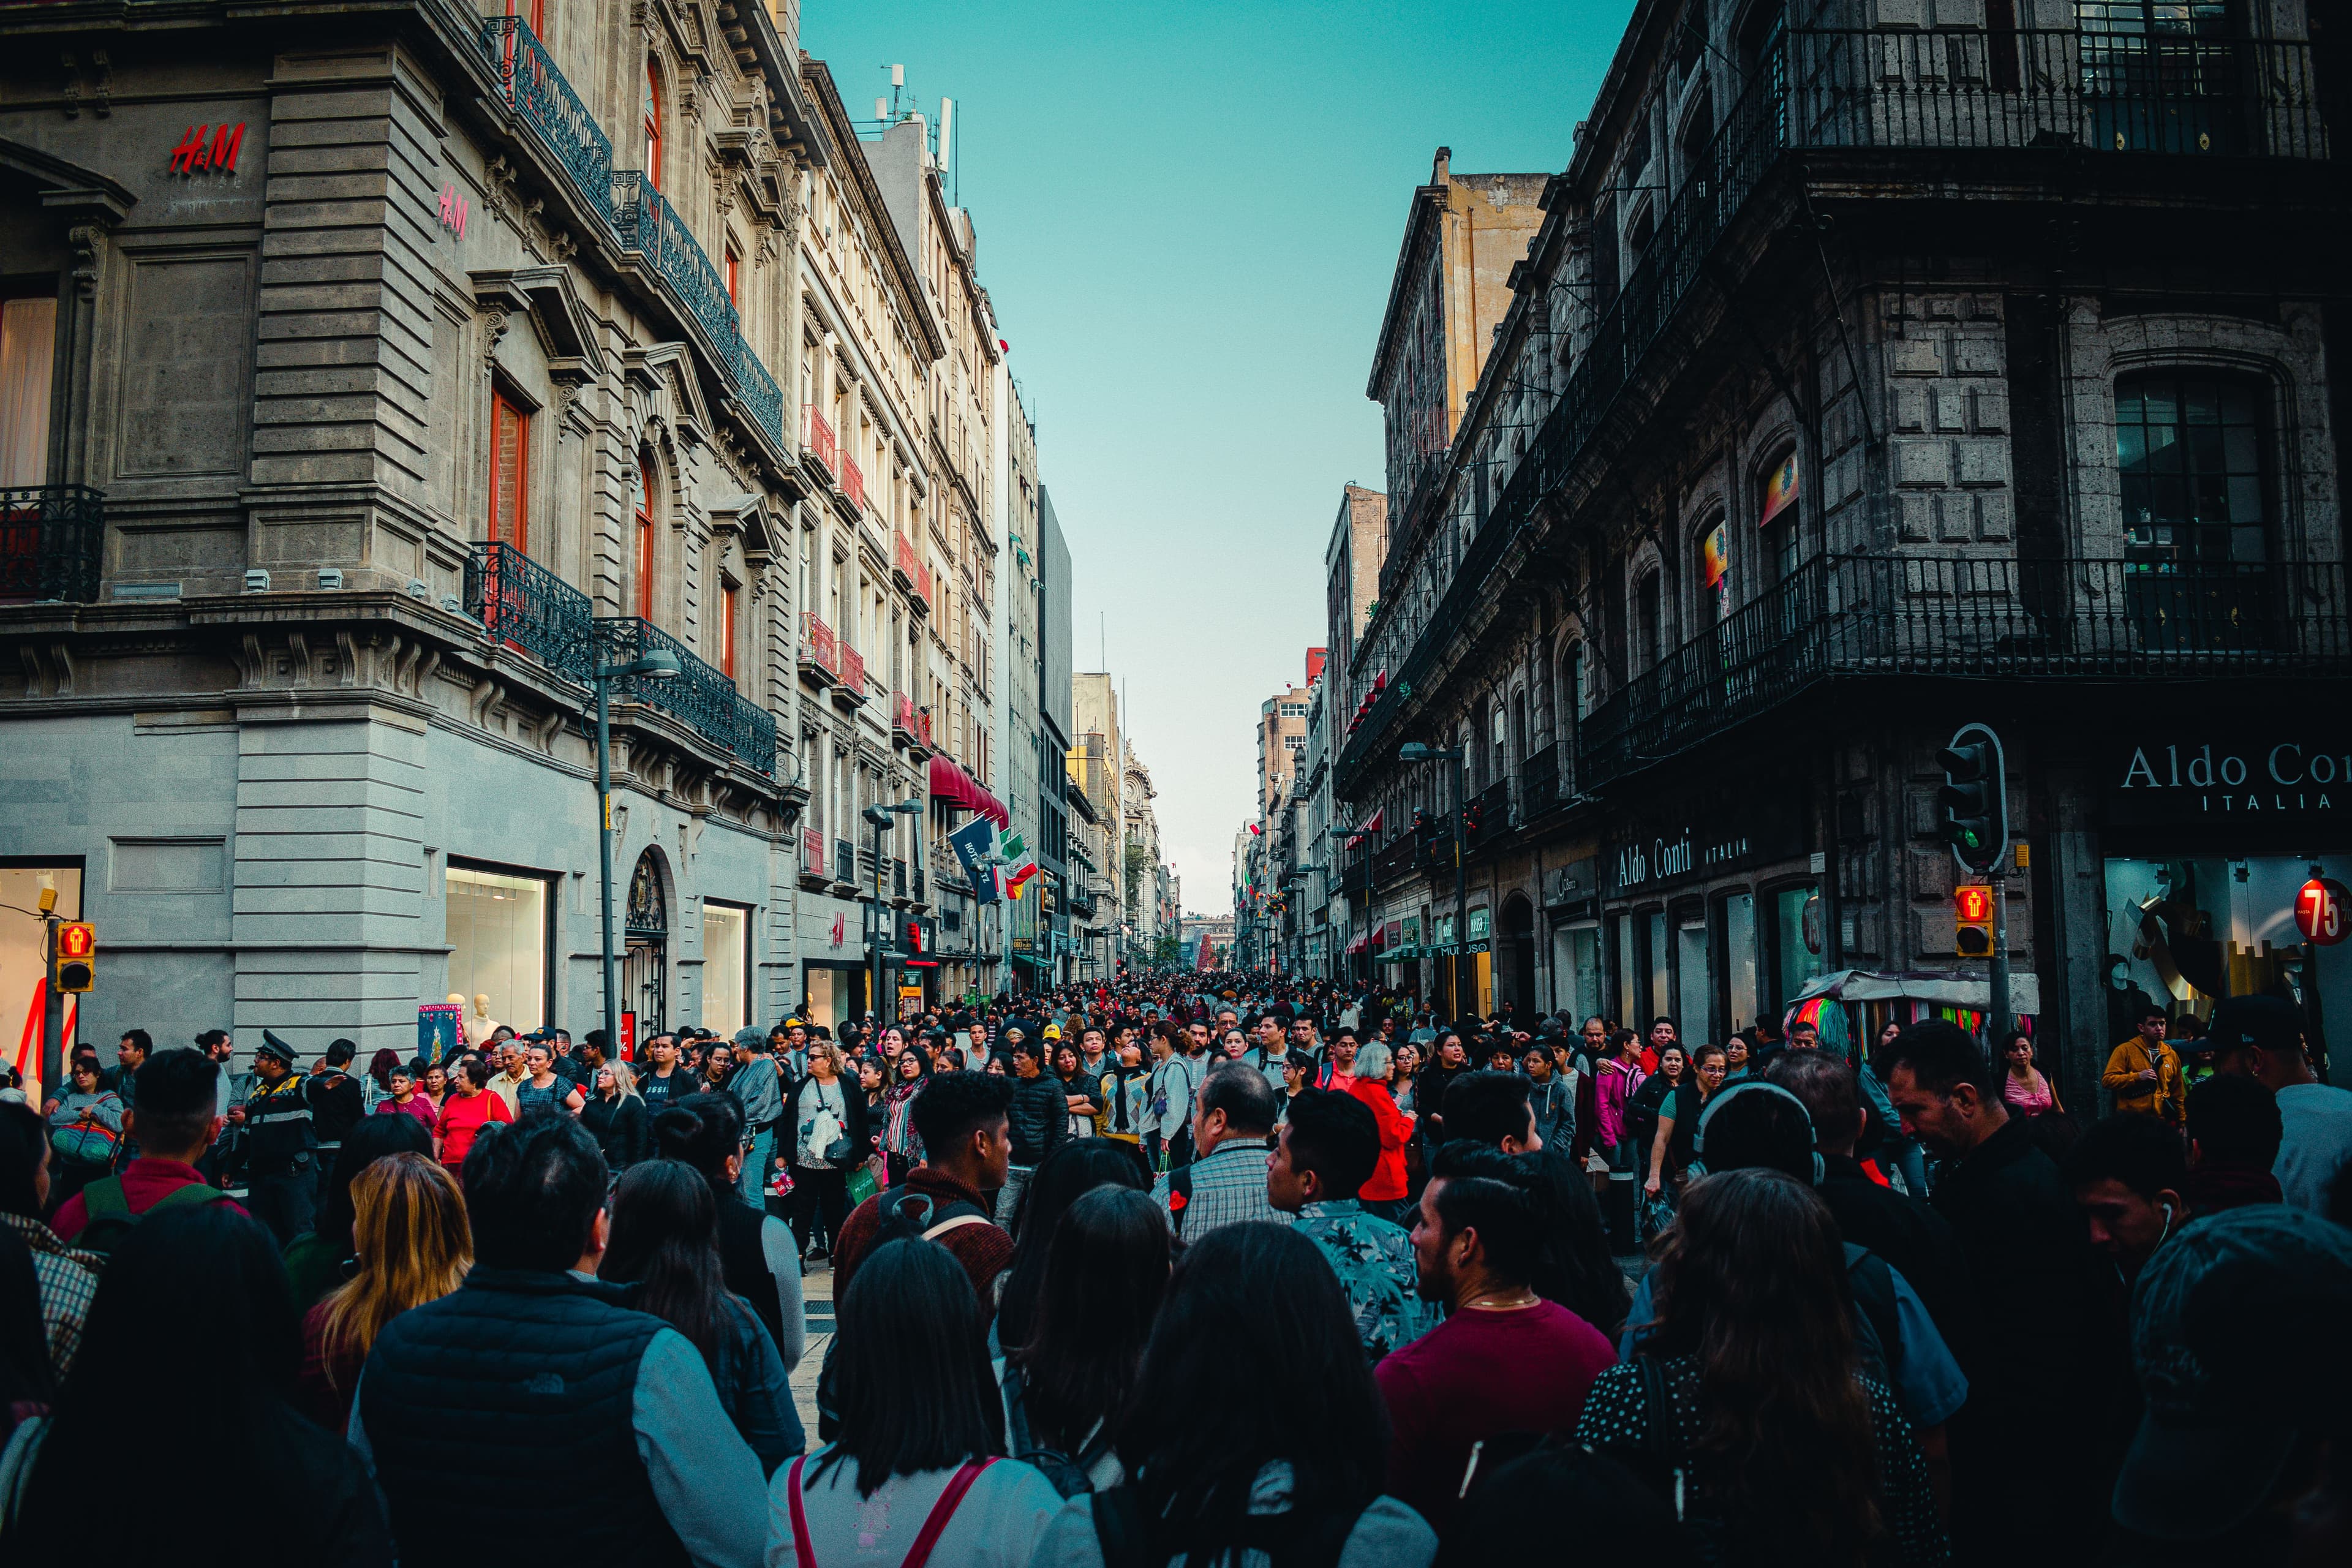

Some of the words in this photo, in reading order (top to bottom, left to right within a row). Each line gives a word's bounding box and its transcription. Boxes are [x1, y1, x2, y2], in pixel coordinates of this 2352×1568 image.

[170, 122, 246, 174] H&M
[437, 181, 470, 241] H&M
[2121, 744, 2247, 788] Aldo
[2204, 794, 2331, 811] ITALIA
[1619, 843, 1645, 887] Aldo
[1655, 827, 1691, 878] Conti
[1706, 838, 1746, 865] ITALIA
